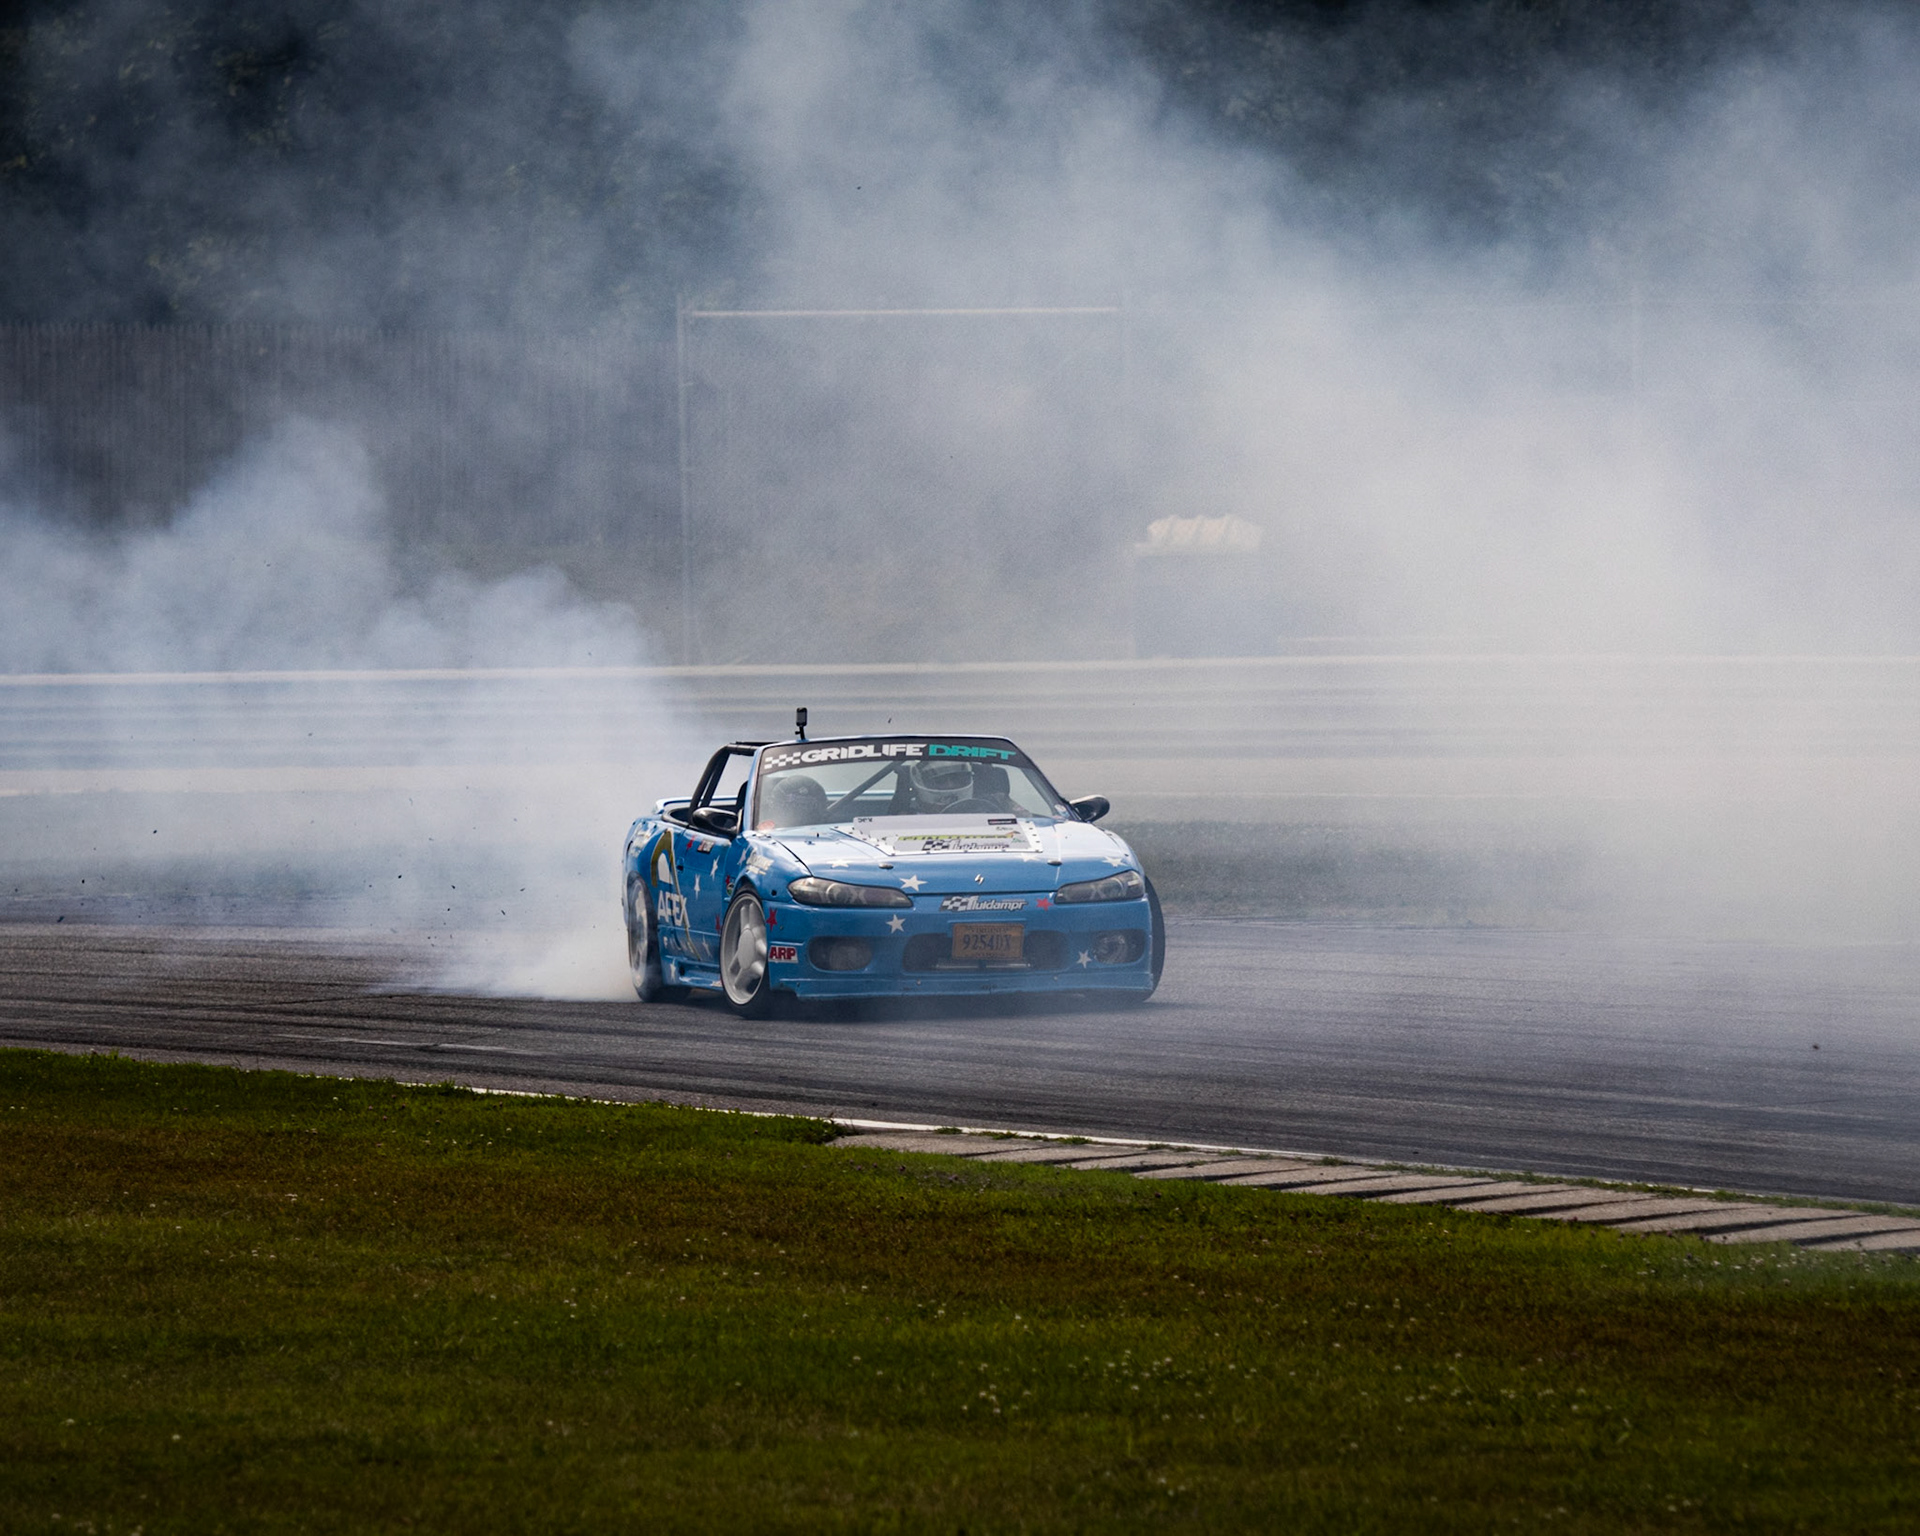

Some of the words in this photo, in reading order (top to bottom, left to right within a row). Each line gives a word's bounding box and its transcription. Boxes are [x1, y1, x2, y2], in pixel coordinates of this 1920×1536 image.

[801, 744, 927, 762] GRIDLIFE
[929, 745, 1016, 759] DRIFT
[657, 891, 690, 928] APEX
[966, 895, 1028, 911] fluidampr
[769, 946, 797, 961] ARP
